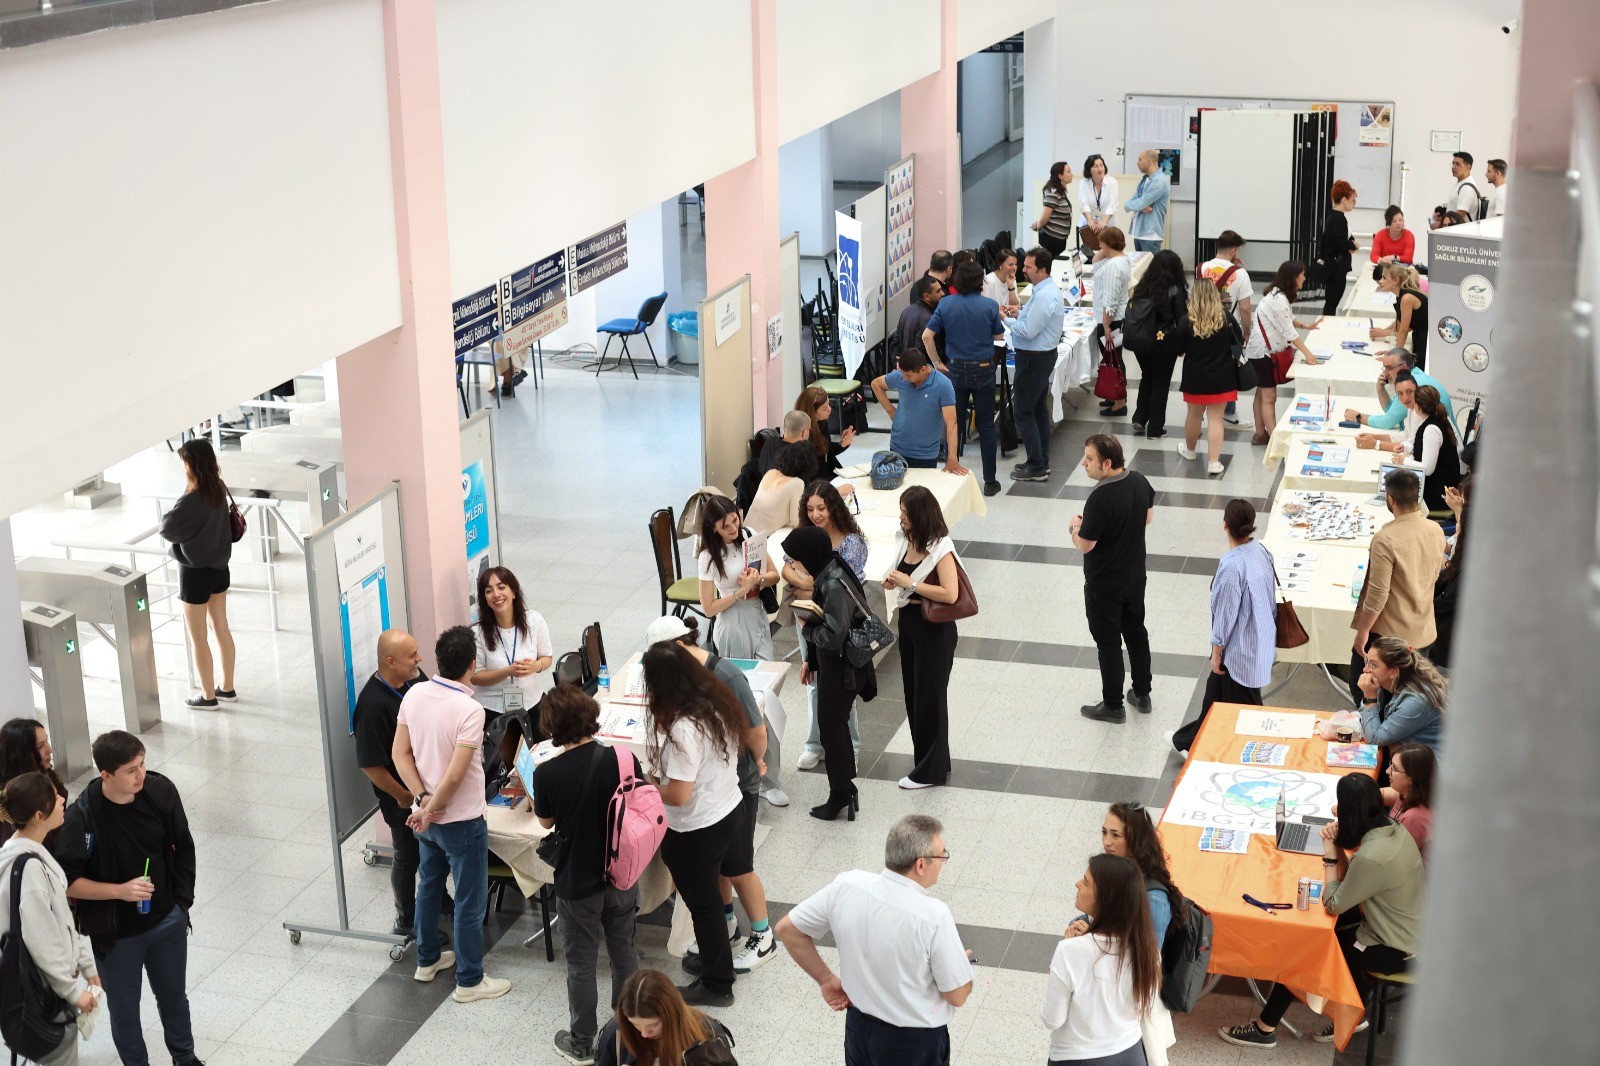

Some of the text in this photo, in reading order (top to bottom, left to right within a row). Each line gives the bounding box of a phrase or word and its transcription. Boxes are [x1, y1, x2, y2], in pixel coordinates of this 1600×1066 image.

[1436, 244, 1459, 253] DOKUZ
[1459, 246, 1478, 255] EYLÜL
[570, 250, 576, 265] E
[1434, 252, 1456, 262] SAĞLIK
[1457, 255, 1487, 266] BİLİMLERİ
[503, 280, 511, 299] B
[504, 288, 555, 325] B Bilgisayar Lab.
